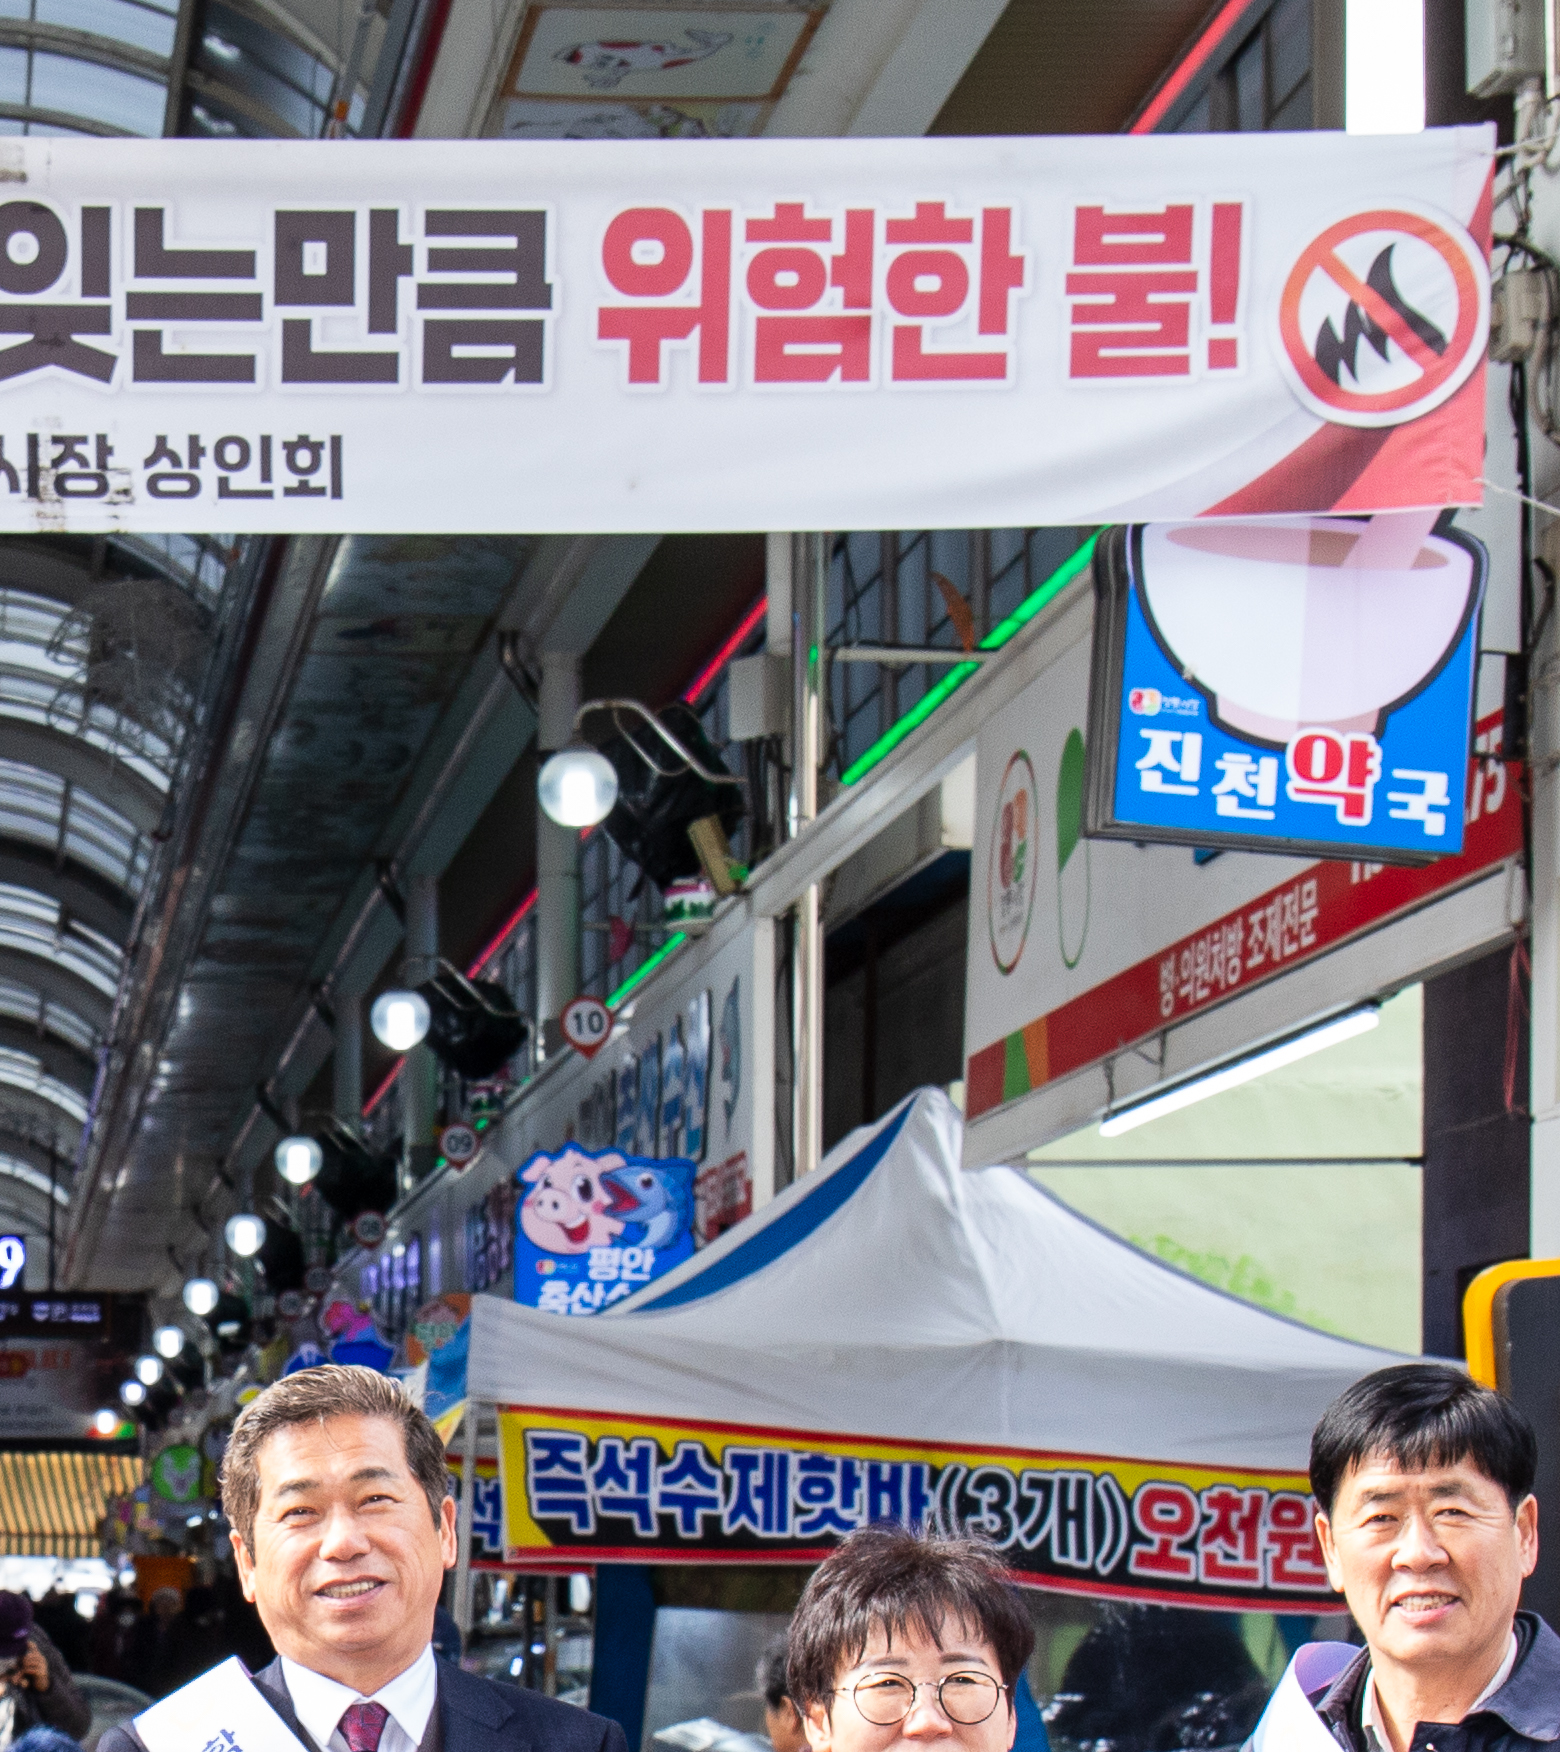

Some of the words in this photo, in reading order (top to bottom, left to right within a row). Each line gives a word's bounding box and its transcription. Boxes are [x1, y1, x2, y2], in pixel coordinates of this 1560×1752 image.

[597, 202, 1026, 385] 위험한
[1065, 200, 1244, 380] 불!
[143, 432, 344, 499] 상인회
[1135, 728, 1451, 836] 진천약국
[1246, 879, 1319, 968] 조제전문
[572, 1010, 604, 1034] 10
[588, 1247, 655, 1282] 평안
